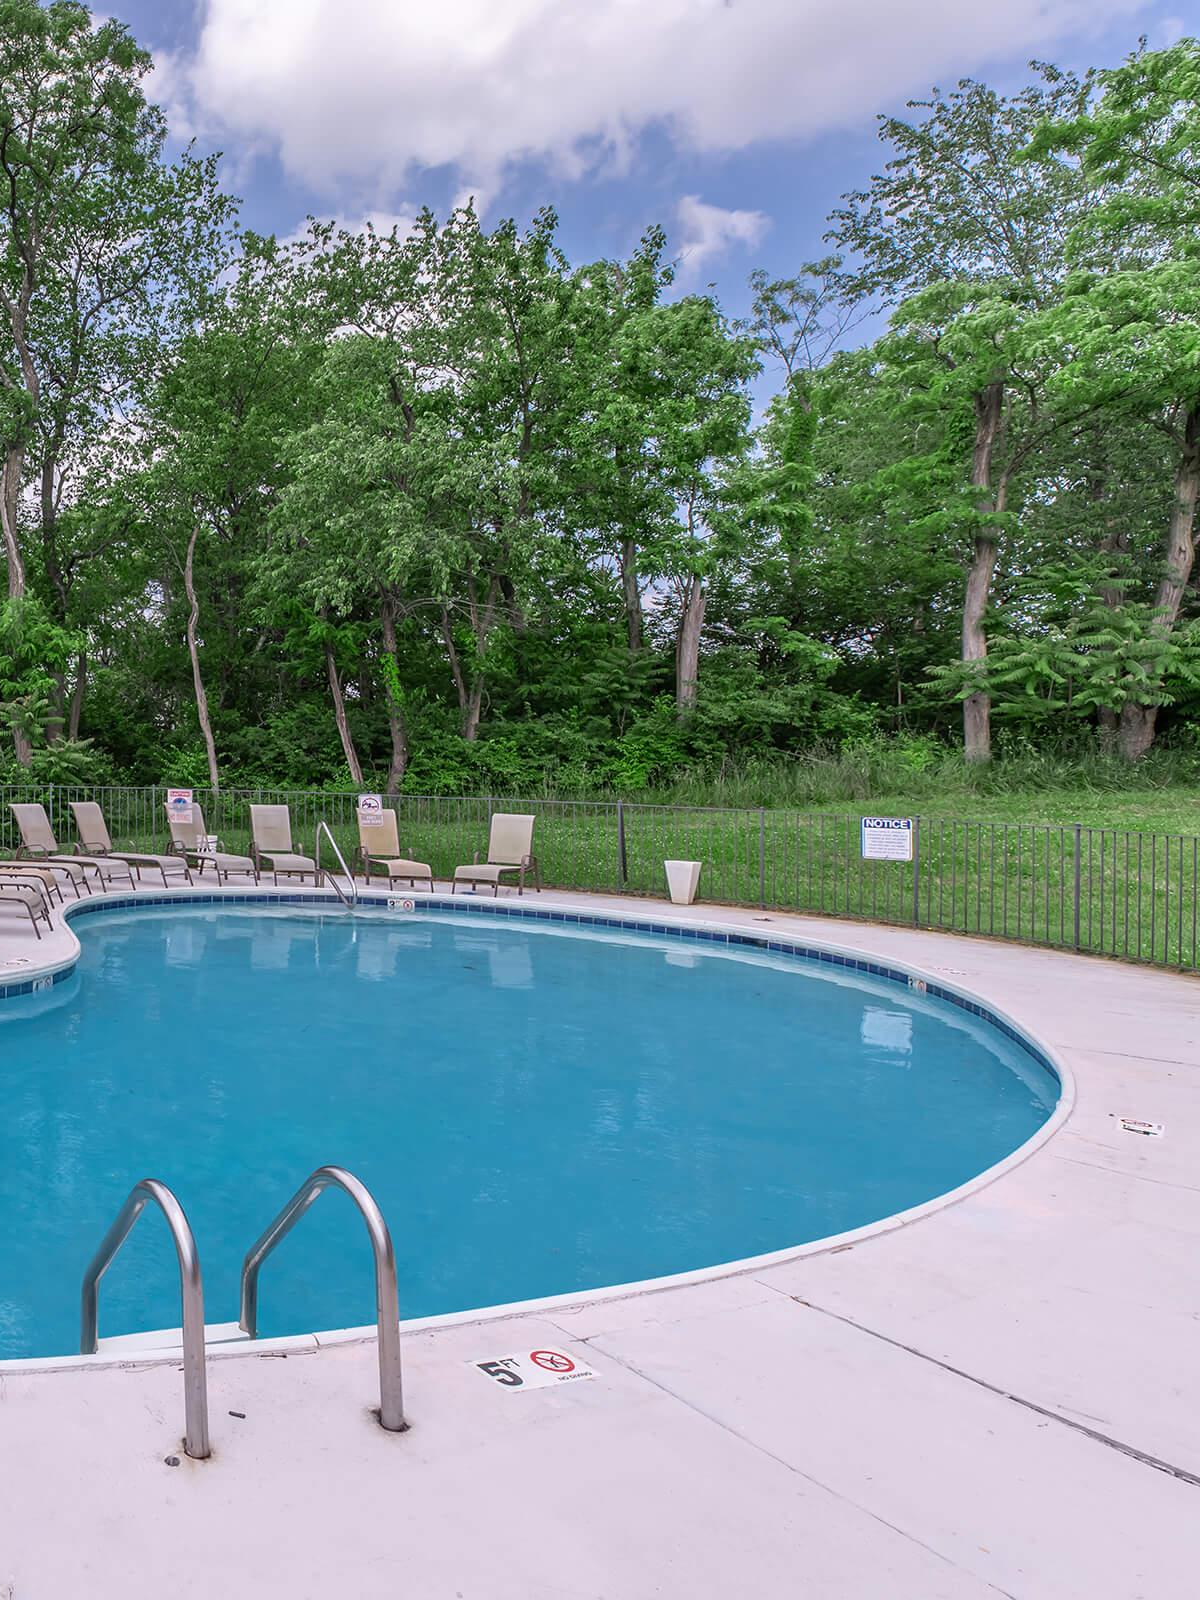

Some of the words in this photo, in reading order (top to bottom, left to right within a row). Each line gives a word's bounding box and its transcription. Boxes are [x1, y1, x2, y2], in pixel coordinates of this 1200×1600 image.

[865, 819, 909, 829] NOTICE
[476, 1361, 523, 1387] 5
[500, 1358, 521, 1369] FT
